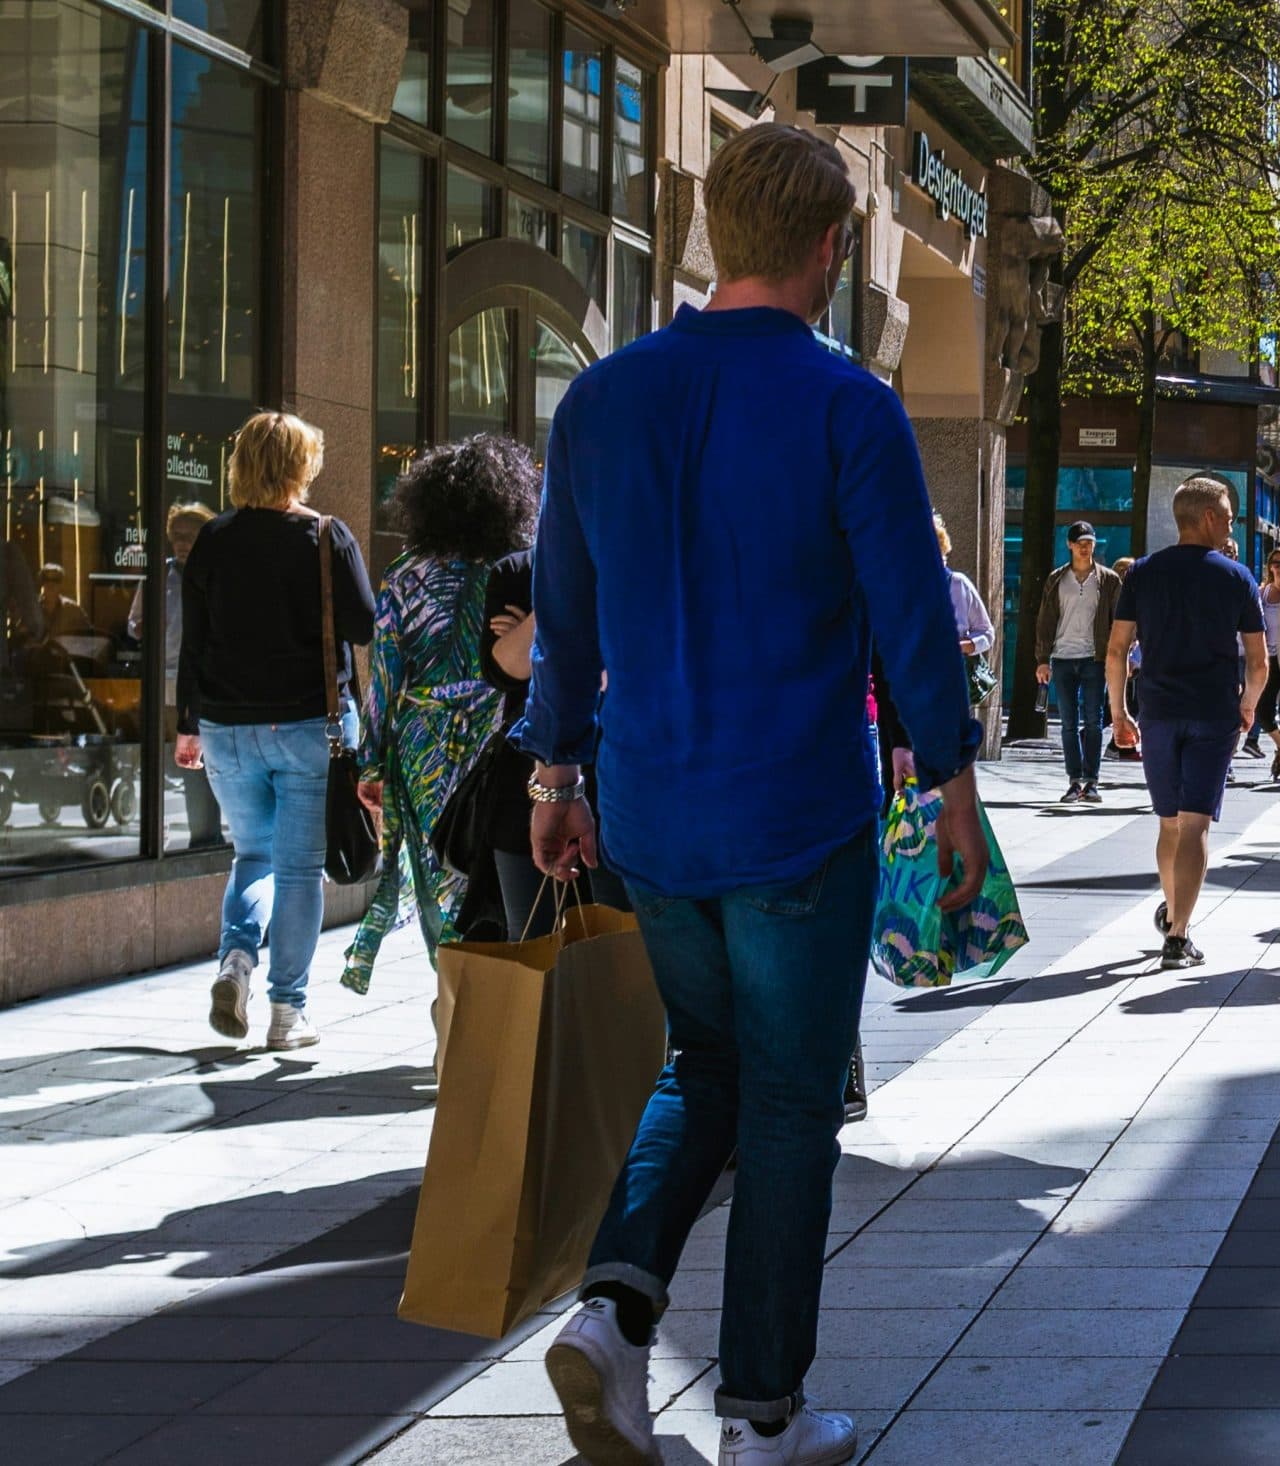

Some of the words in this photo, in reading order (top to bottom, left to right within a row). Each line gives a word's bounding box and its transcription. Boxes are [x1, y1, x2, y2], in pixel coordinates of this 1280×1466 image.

[919, 131, 988, 241] Designtorget
[167, 434, 182, 450] ew
[167, 455, 209, 478] ollection
[126, 527, 149, 543] new
[114, 546, 148, 567] denim
